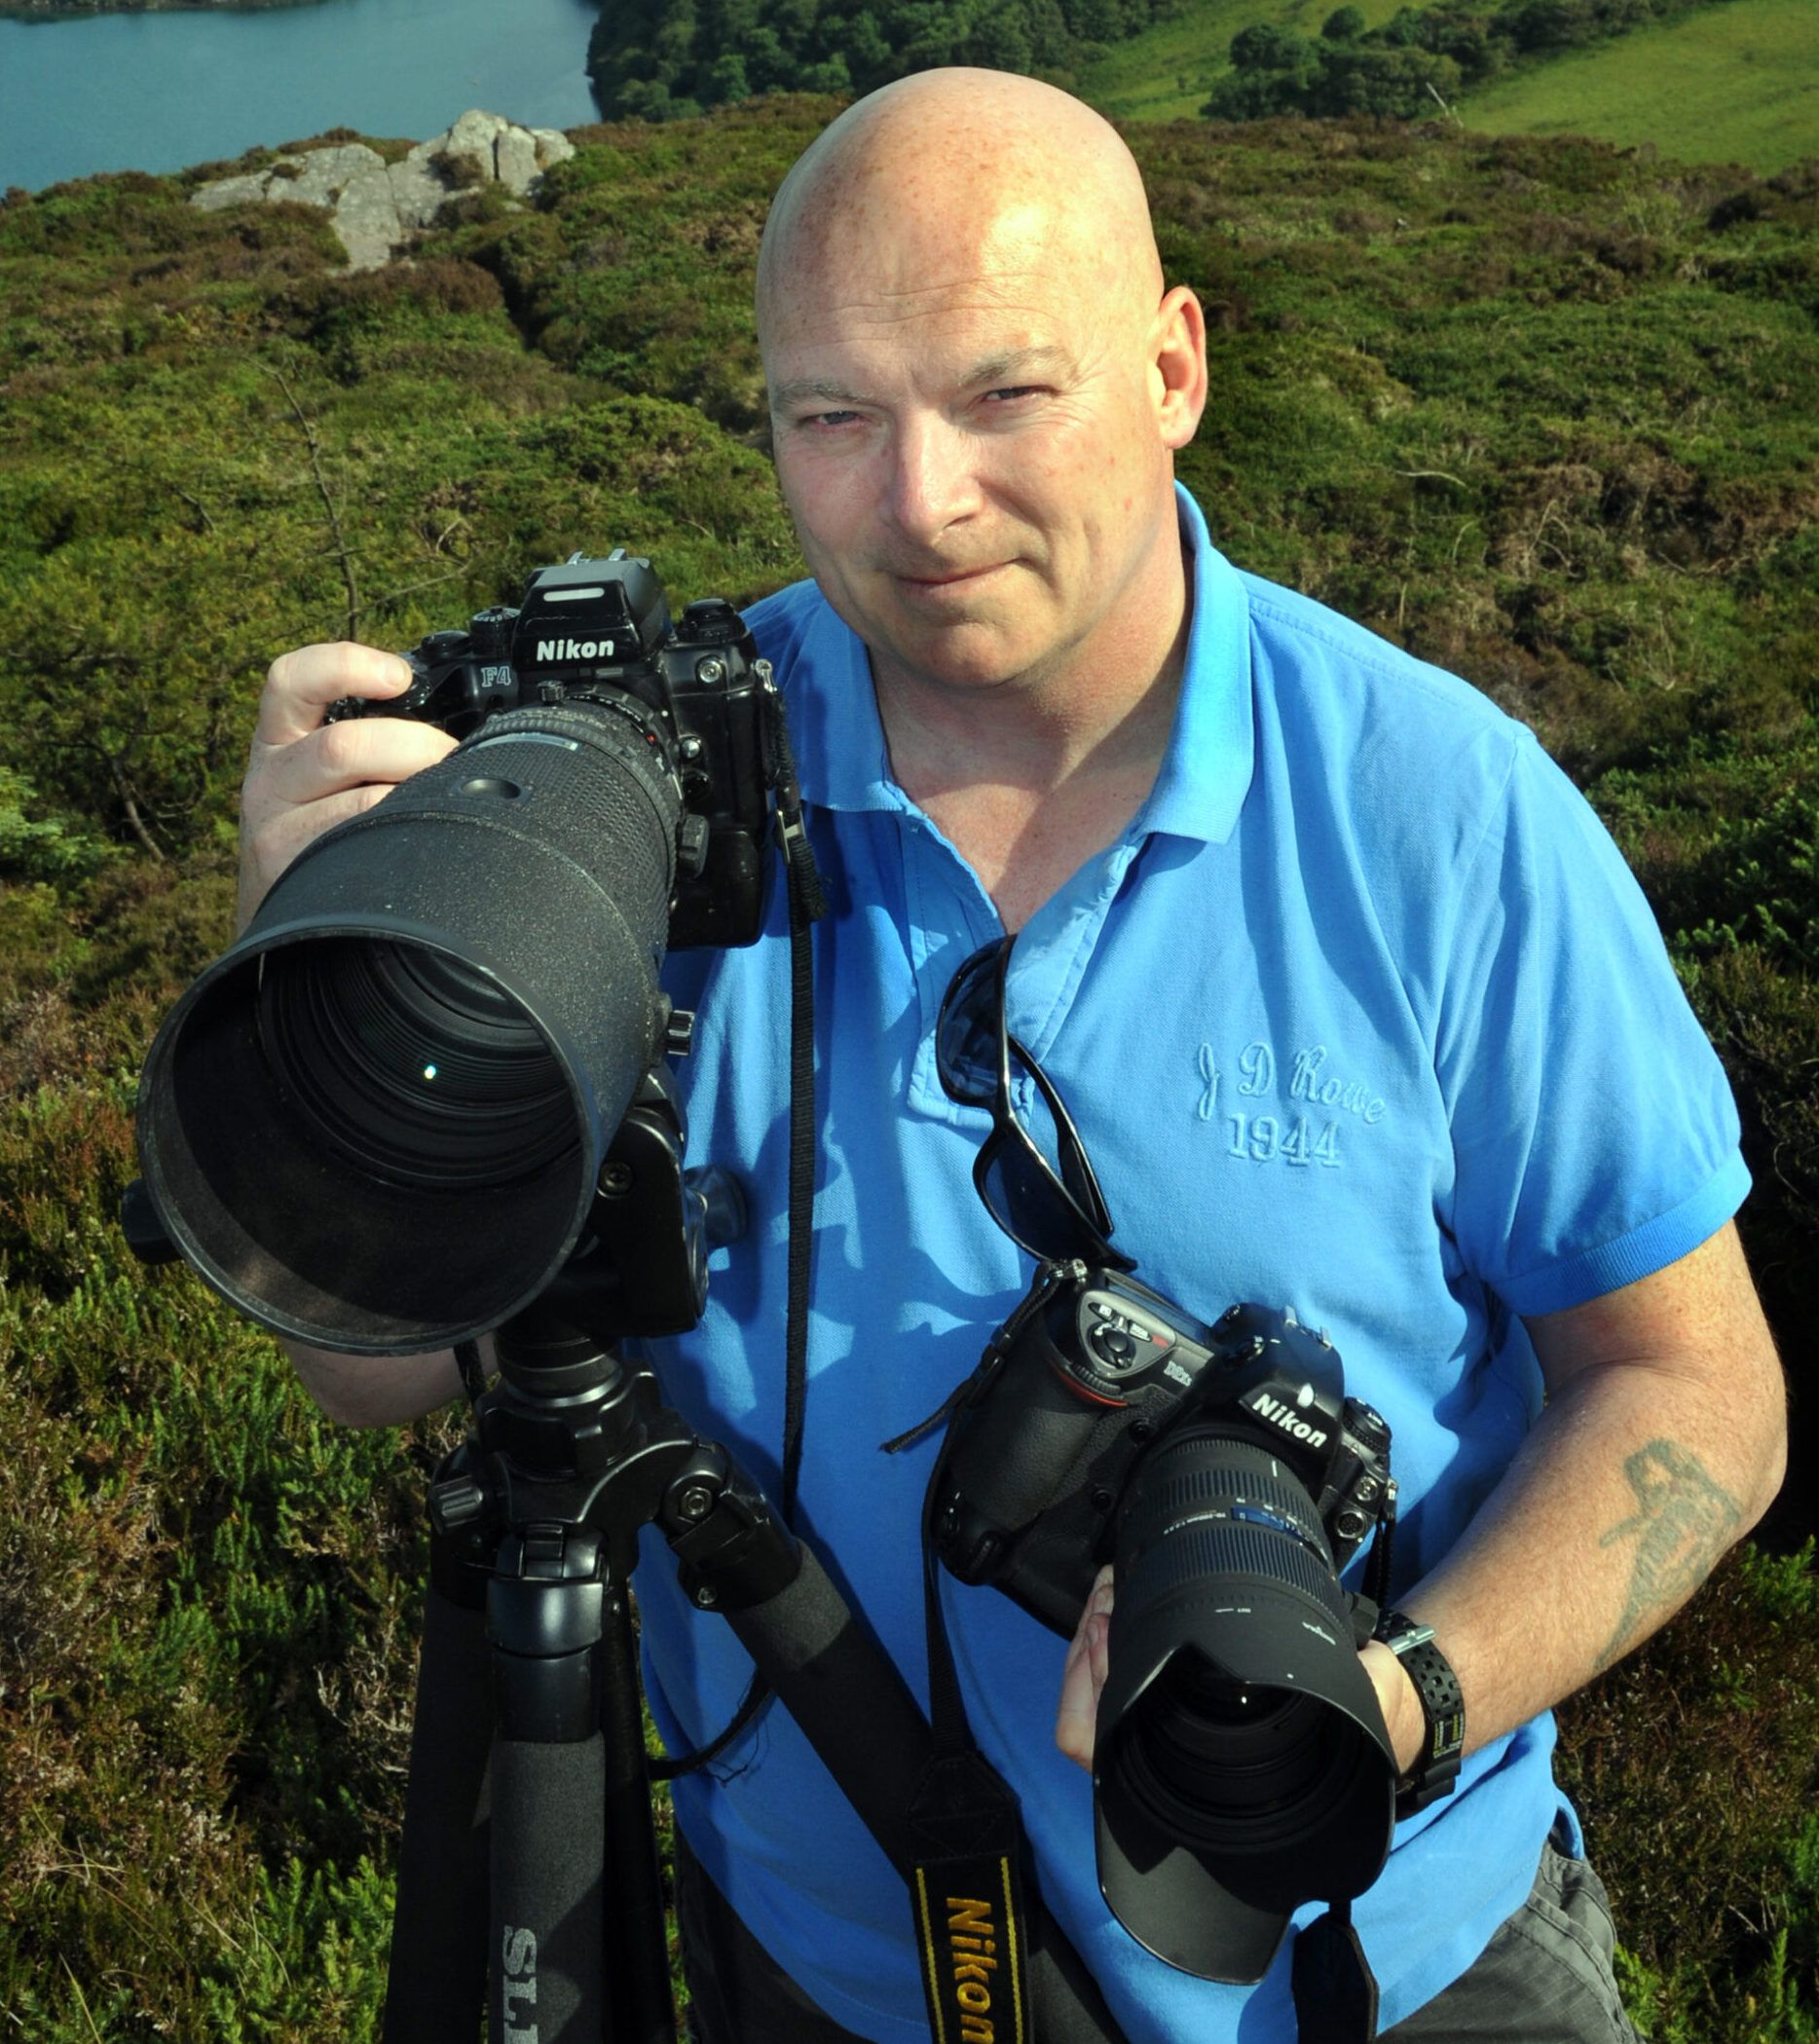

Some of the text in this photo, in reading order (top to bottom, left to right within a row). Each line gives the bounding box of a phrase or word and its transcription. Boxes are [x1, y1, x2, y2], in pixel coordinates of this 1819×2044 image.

[481, 665, 511, 688] F4
[537, 638, 614, 661] Nikon
[1199, 1042, 1219, 1122] J
[1238, 1041, 1276, 1098] D
[1228, 1112, 1341, 1167] 1944
[1252, 1394, 1327, 1448] Nikon
[947, 1897, 997, 2044] Nikon
